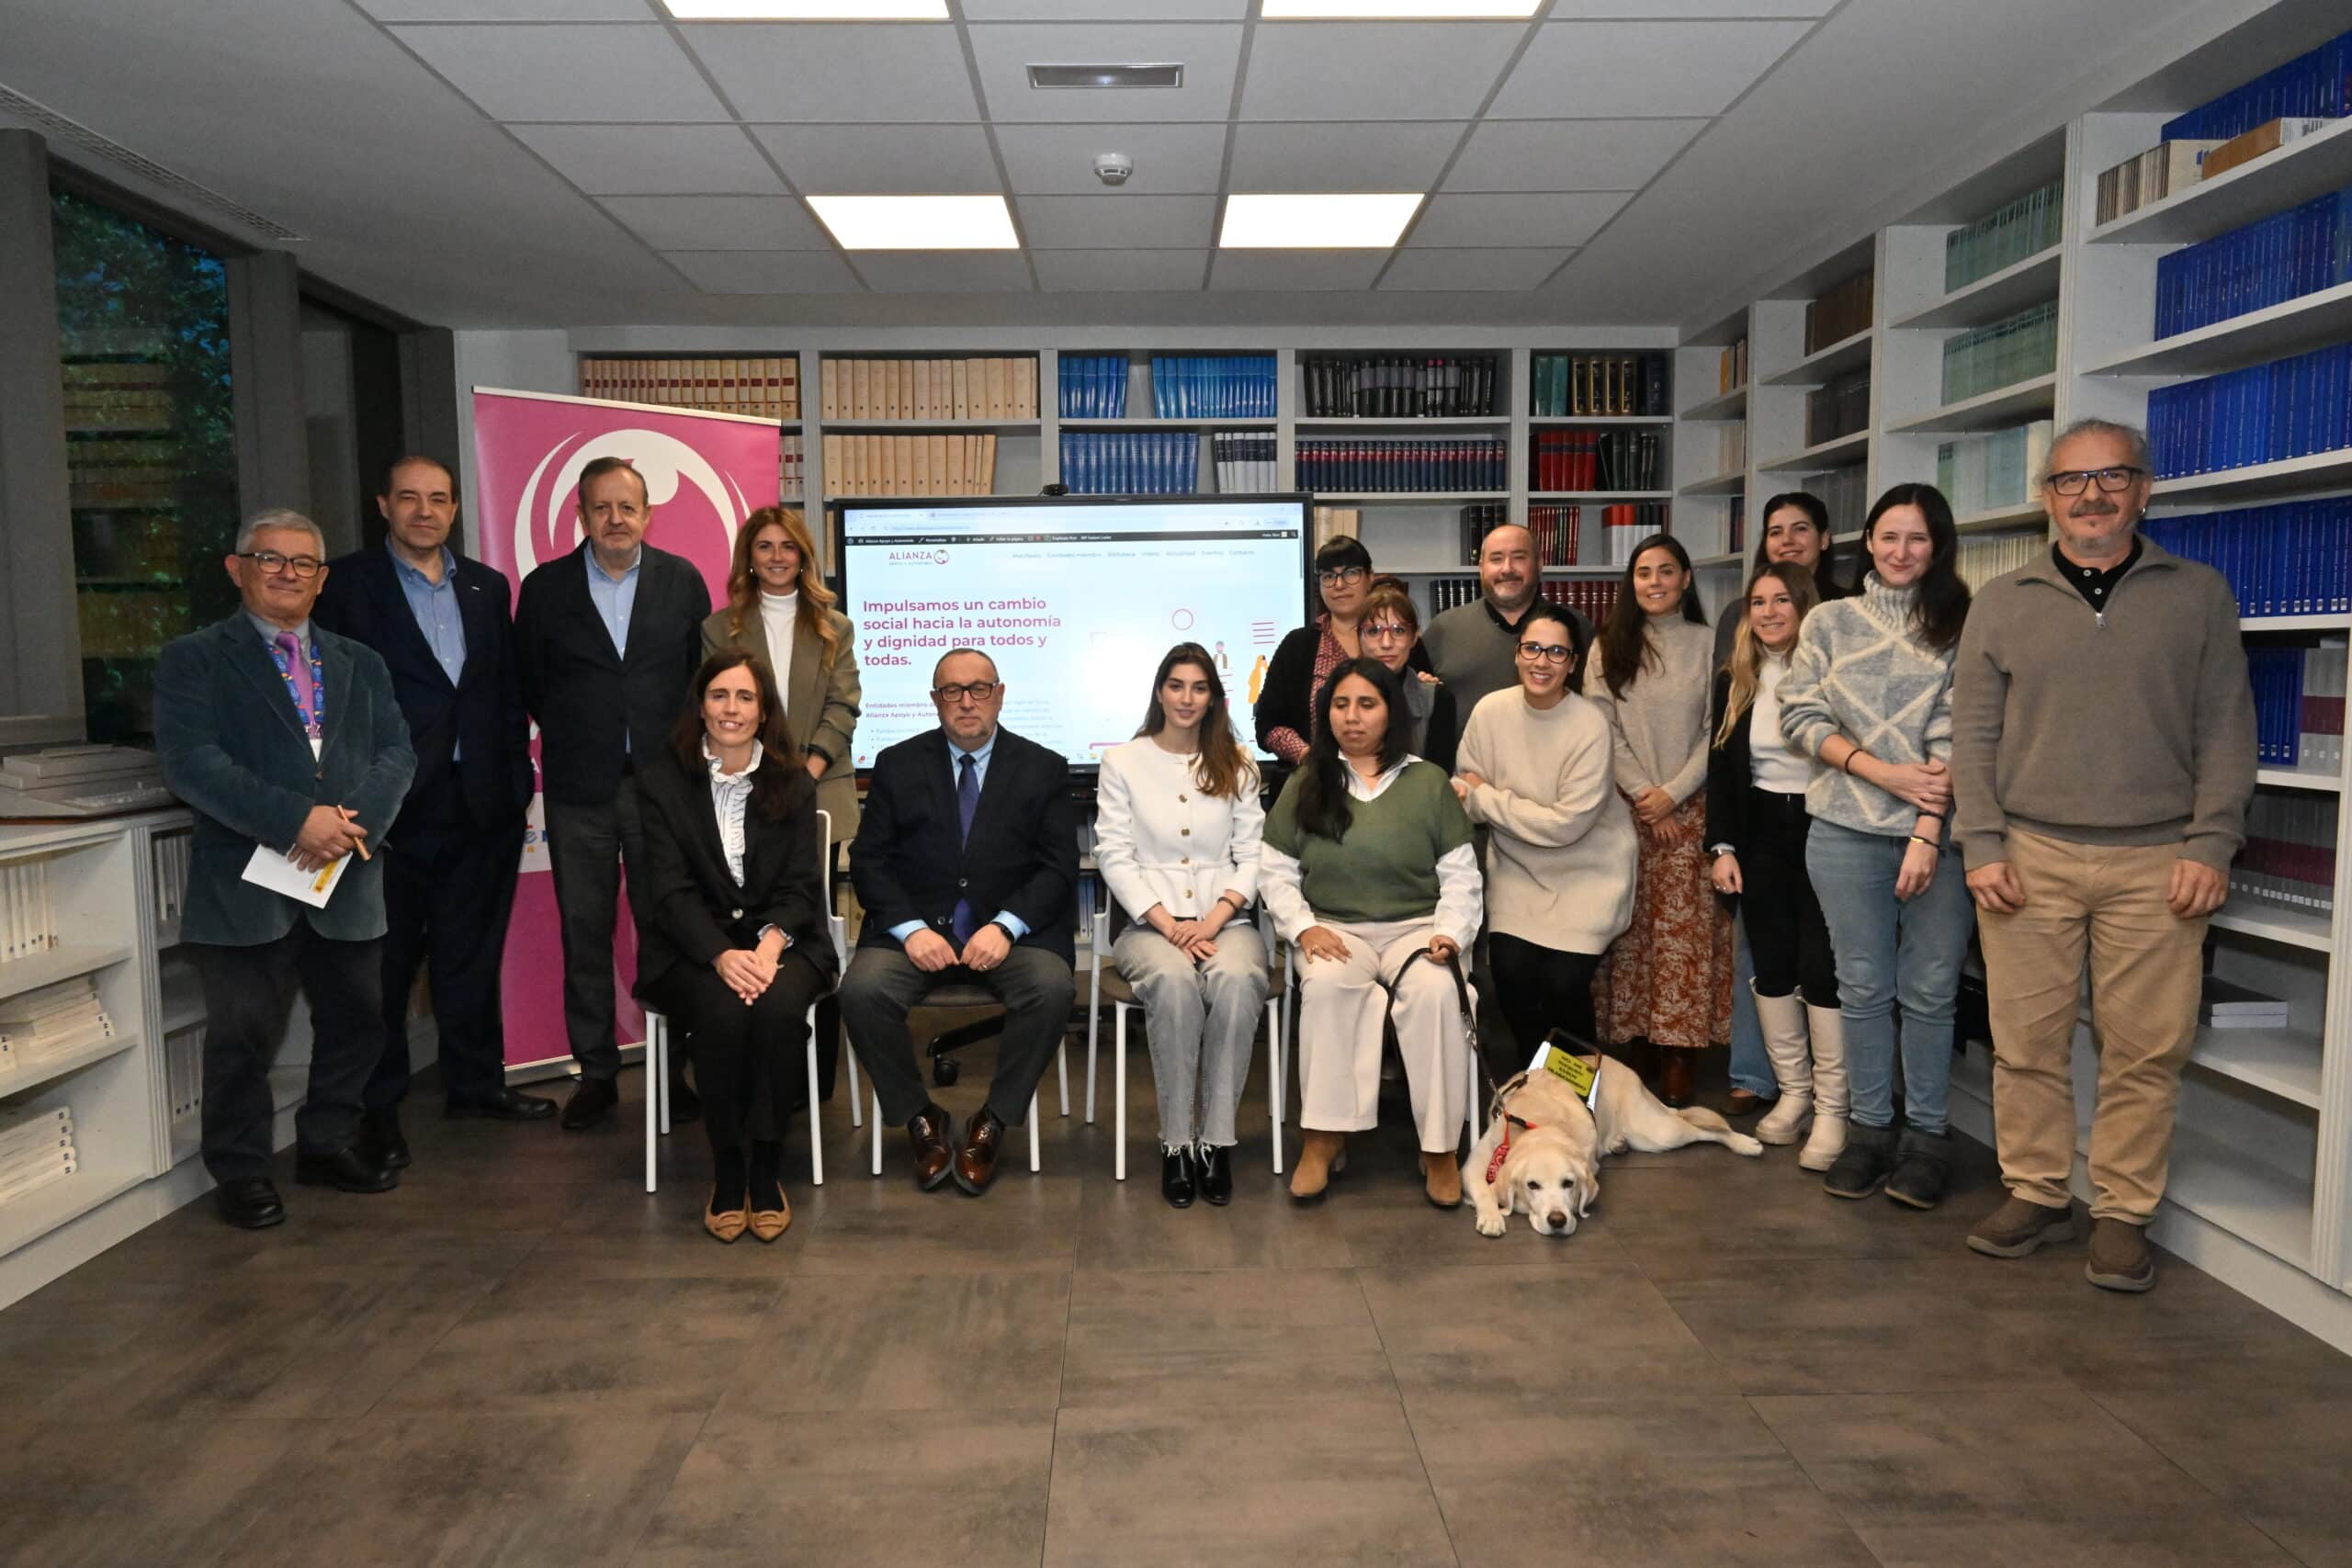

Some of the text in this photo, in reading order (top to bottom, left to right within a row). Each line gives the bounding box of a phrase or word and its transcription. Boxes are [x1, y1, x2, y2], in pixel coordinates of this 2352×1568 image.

[889, 551, 932, 560] ALIANZA
[863, 596, 1046, 615] Impulsamos un cambio
[864, 615, 1061, 630] social hacia la autonomía
[864, 634, 1047, 650] y dignidad para todos y
[865, 653, 912, 666] todas.
